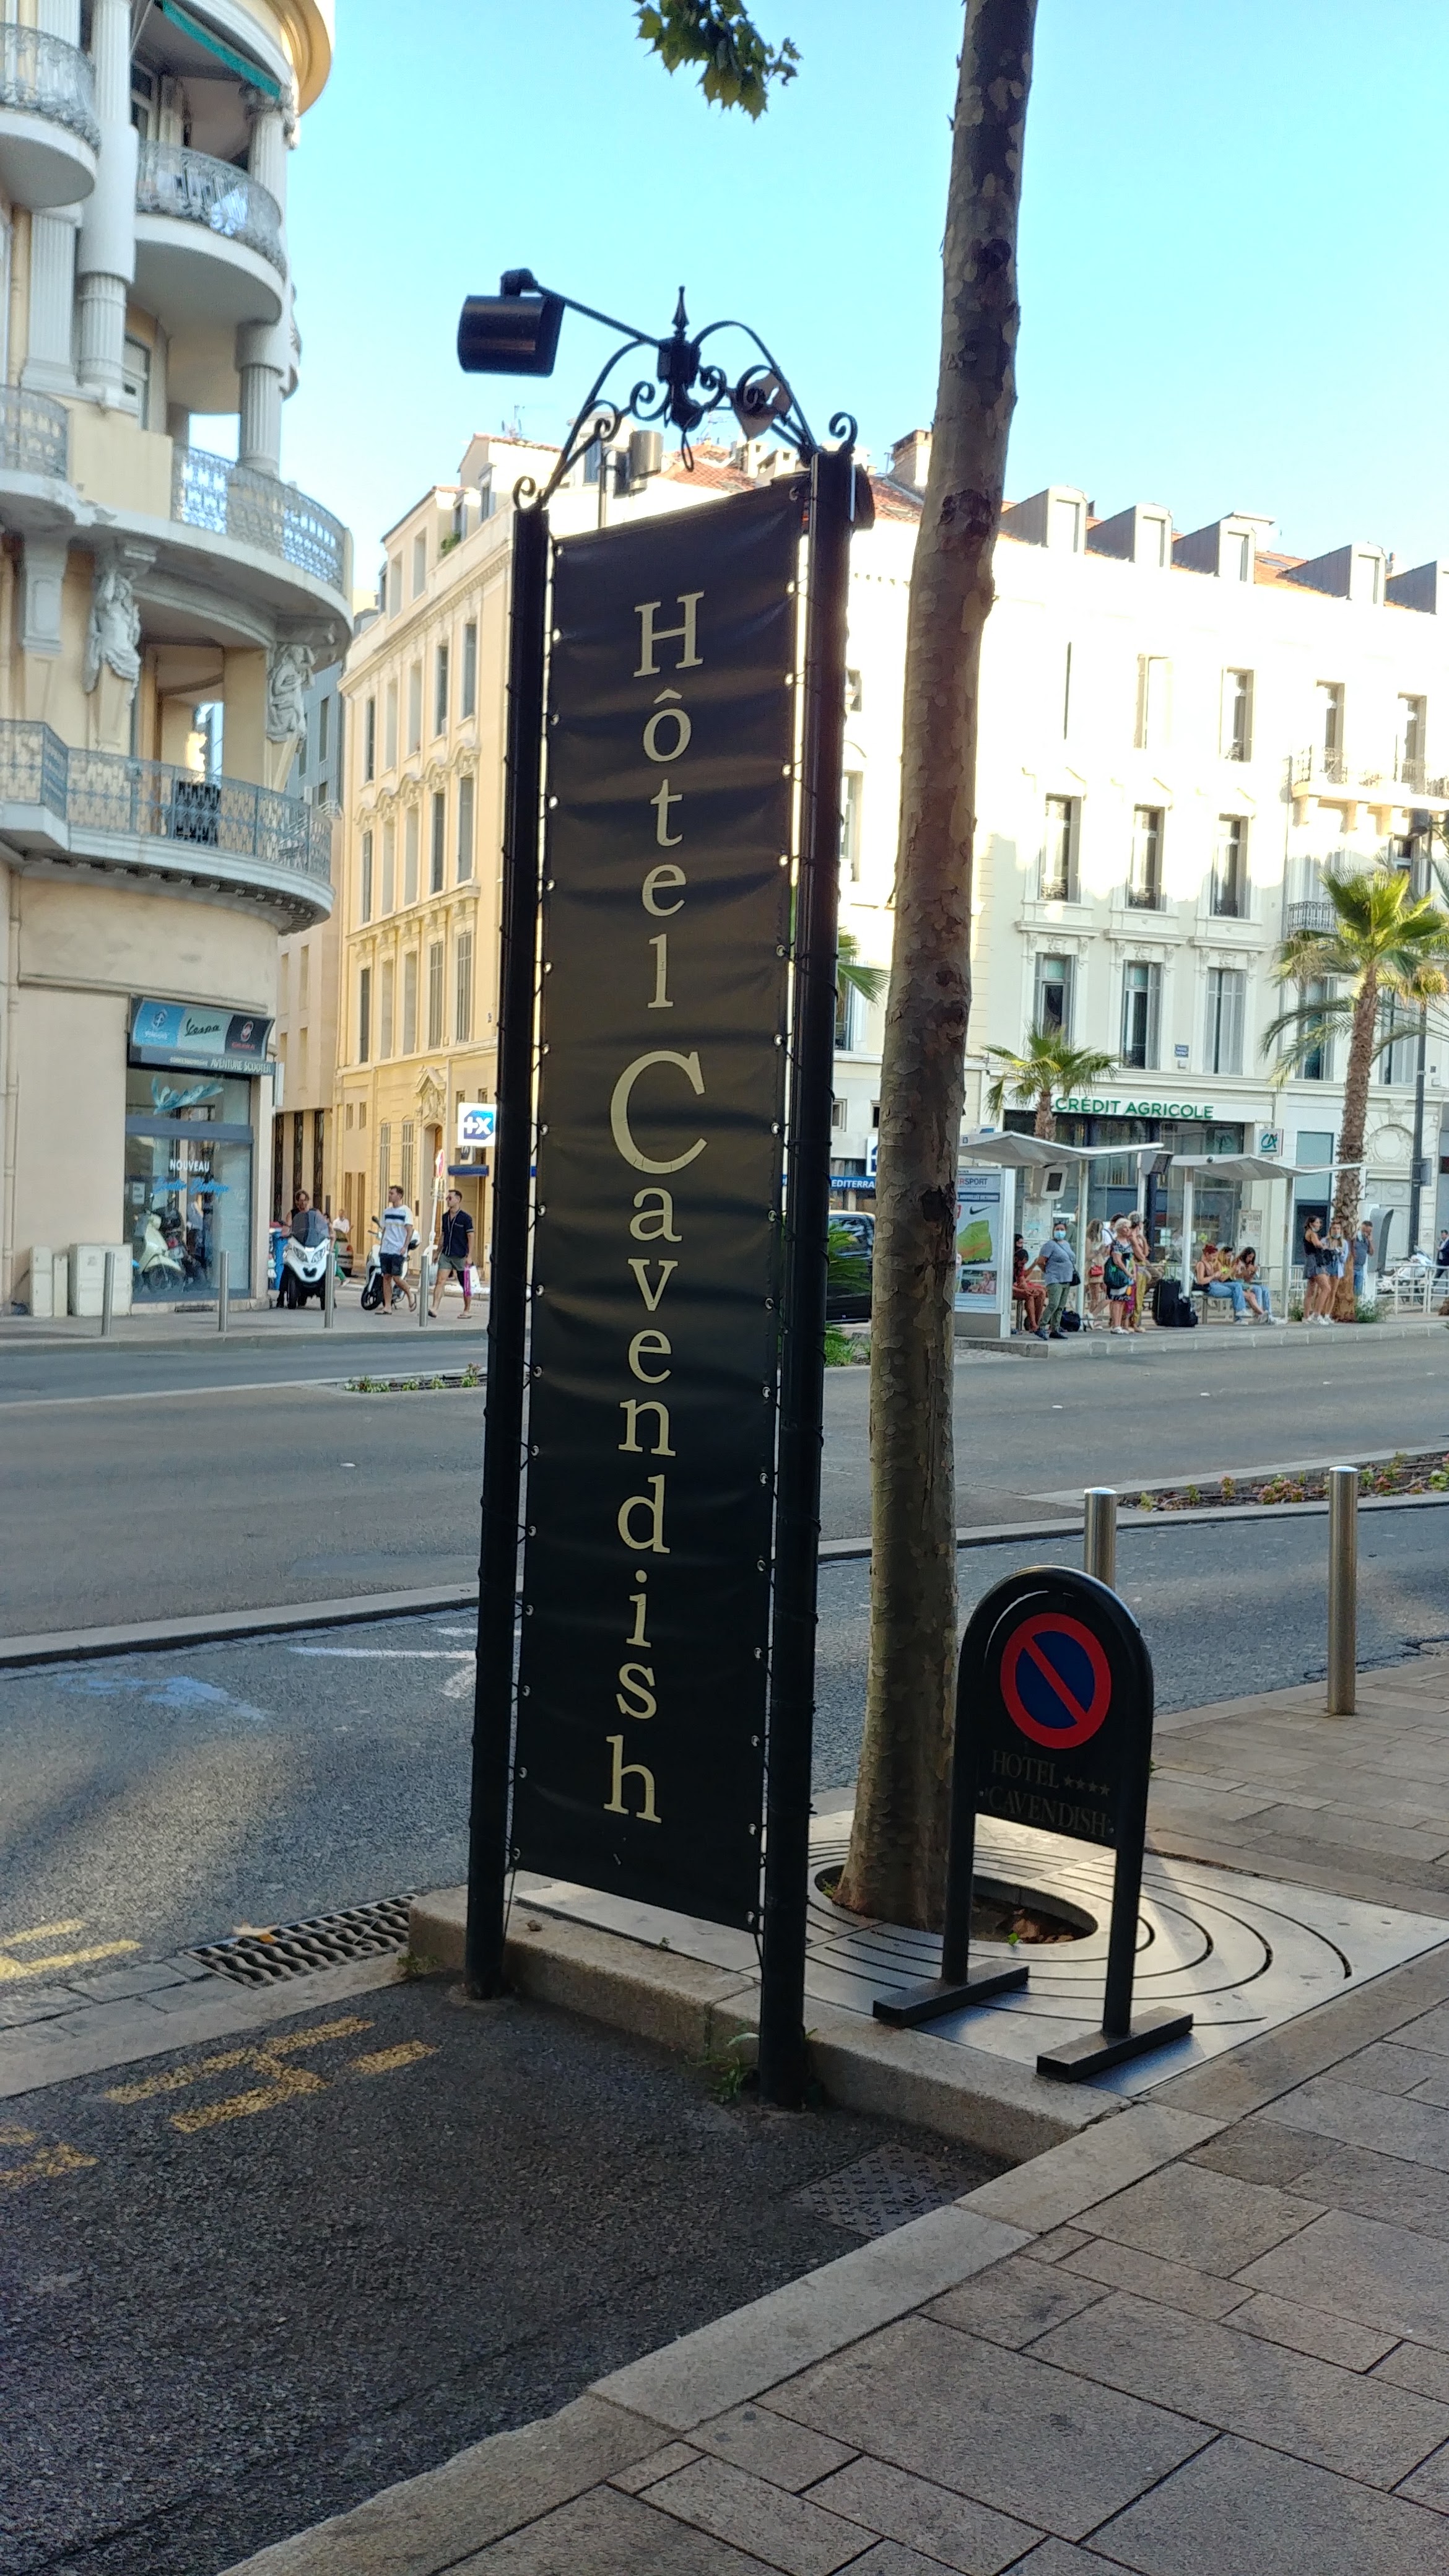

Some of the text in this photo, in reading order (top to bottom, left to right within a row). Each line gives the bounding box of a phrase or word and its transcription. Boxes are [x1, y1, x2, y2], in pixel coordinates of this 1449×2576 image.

[185, 1018, 221, 1037] Vespa
[1055, 1096, 1214, 1118] CRÉDIT AGRICOLE
[169, 1159, 210, 1172] NOUVEAU
[831, 1179, 875, 1189] EDITERRA
[603, 590, 708, 1824] Hôtel Cavendish
[991, 1749, 1060, 1788] HOTEL
